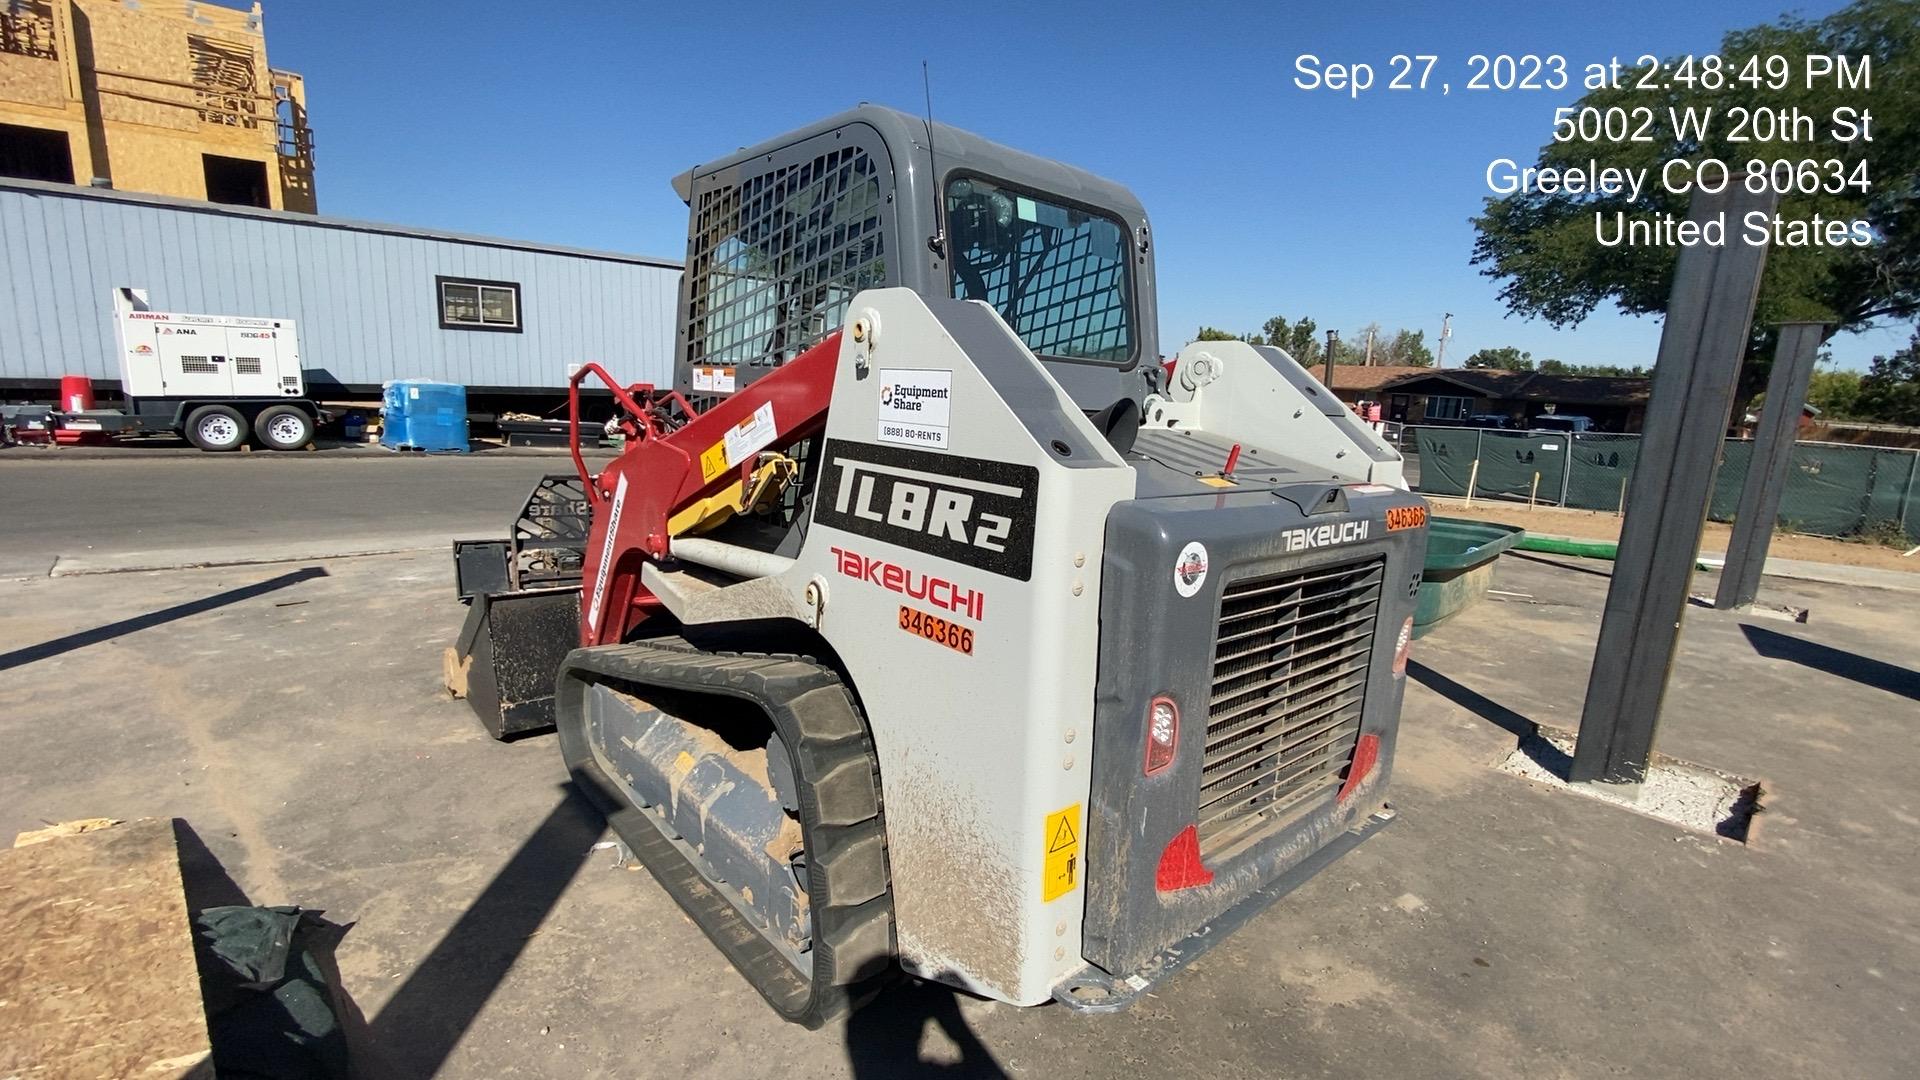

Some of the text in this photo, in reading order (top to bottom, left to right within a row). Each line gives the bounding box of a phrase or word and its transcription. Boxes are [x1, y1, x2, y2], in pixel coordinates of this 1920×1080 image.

[128, 312, 169, 321] AIRMAN
[175, 328, 197, 336] ANA
[894, 384, 948, 400] Equipment
[893, 398, 922, 412] Share
[904, 429, 942, 443] 80-RENTS
[1386, 505, 1426, 531] 346366
[1281, 519, 1370, 552] TAKEUCHI
[596, 499, 623, 599] EquipmentShare
[830, 546, 985, 622] TAKEUCHI
[899, 605, 974, 655] 346366
